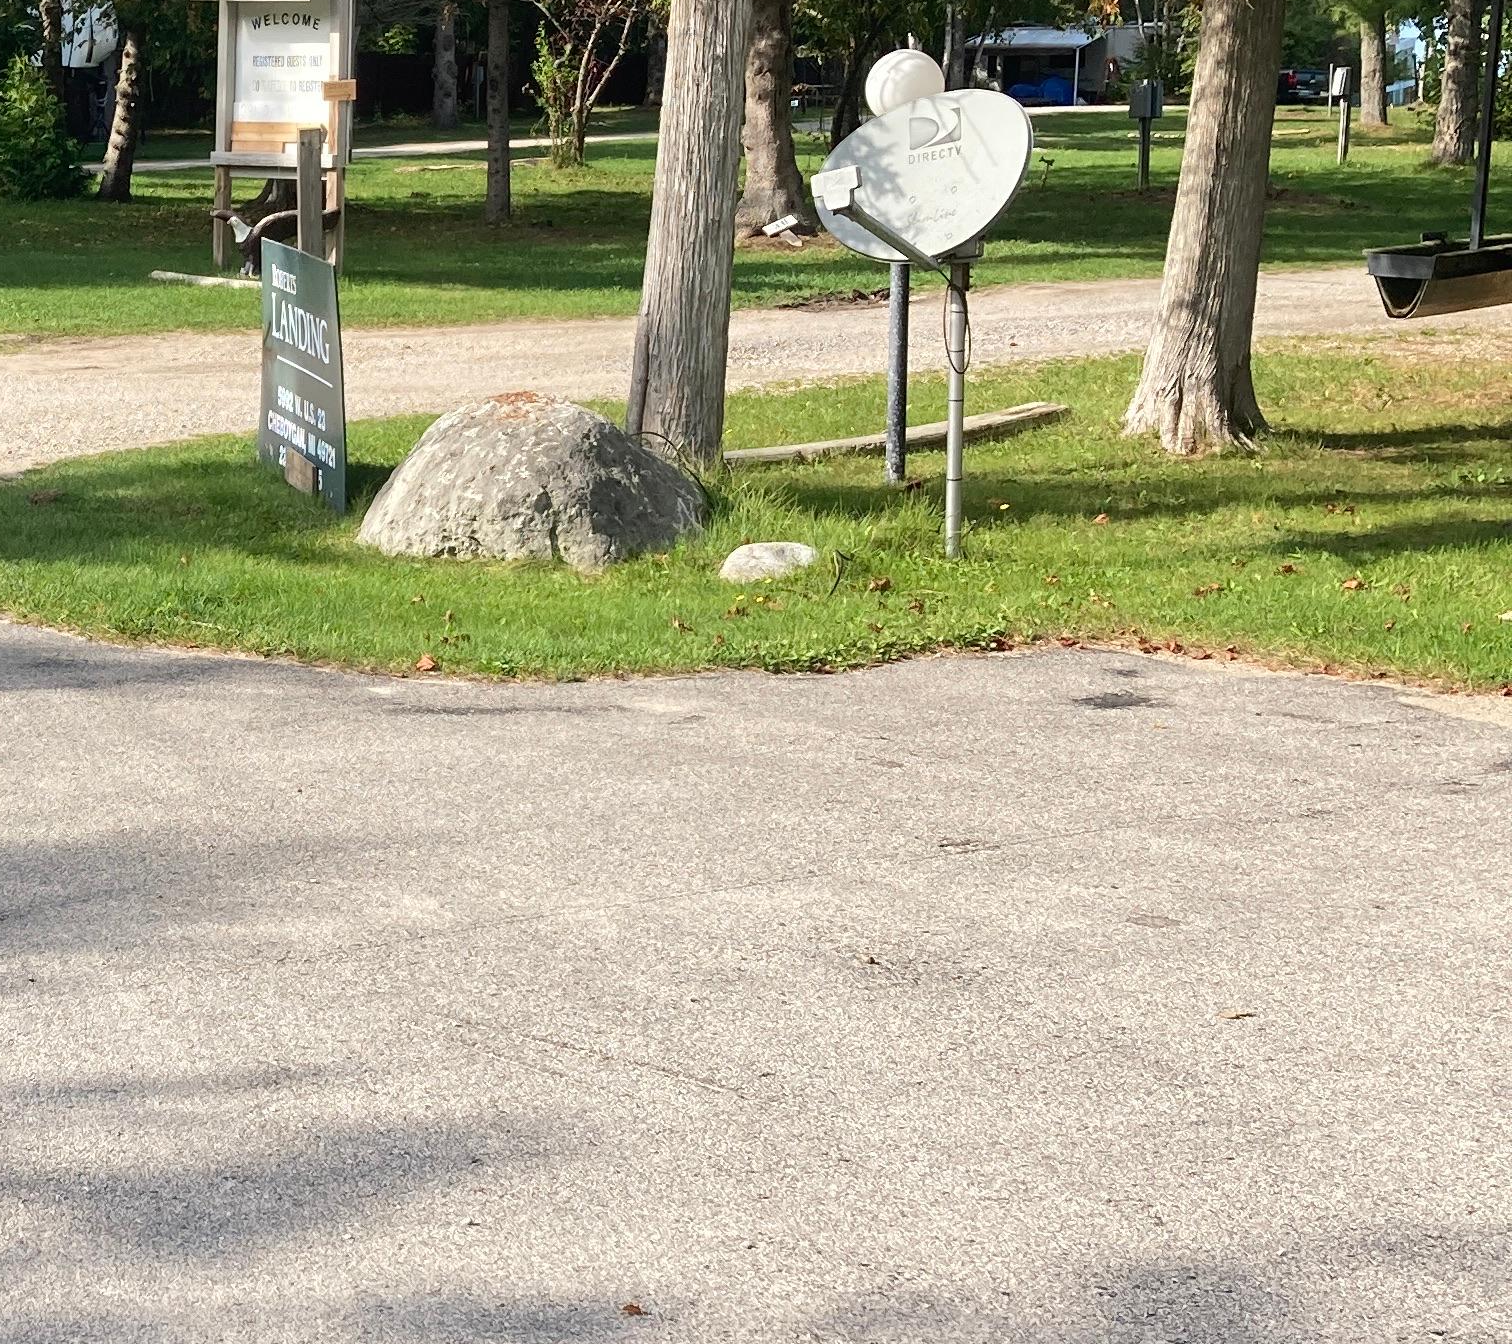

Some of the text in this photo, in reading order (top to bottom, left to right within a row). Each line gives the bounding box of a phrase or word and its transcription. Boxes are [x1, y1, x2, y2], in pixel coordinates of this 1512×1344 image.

[251, 13, 321, 31] WELCOME
[252, 56, 285, 67] REGISTERED
[287, 56, 307, 67] GUESTS
[908, 145, 962, 165] DIRECTV
[271, 291, 330, 364] LANDING
